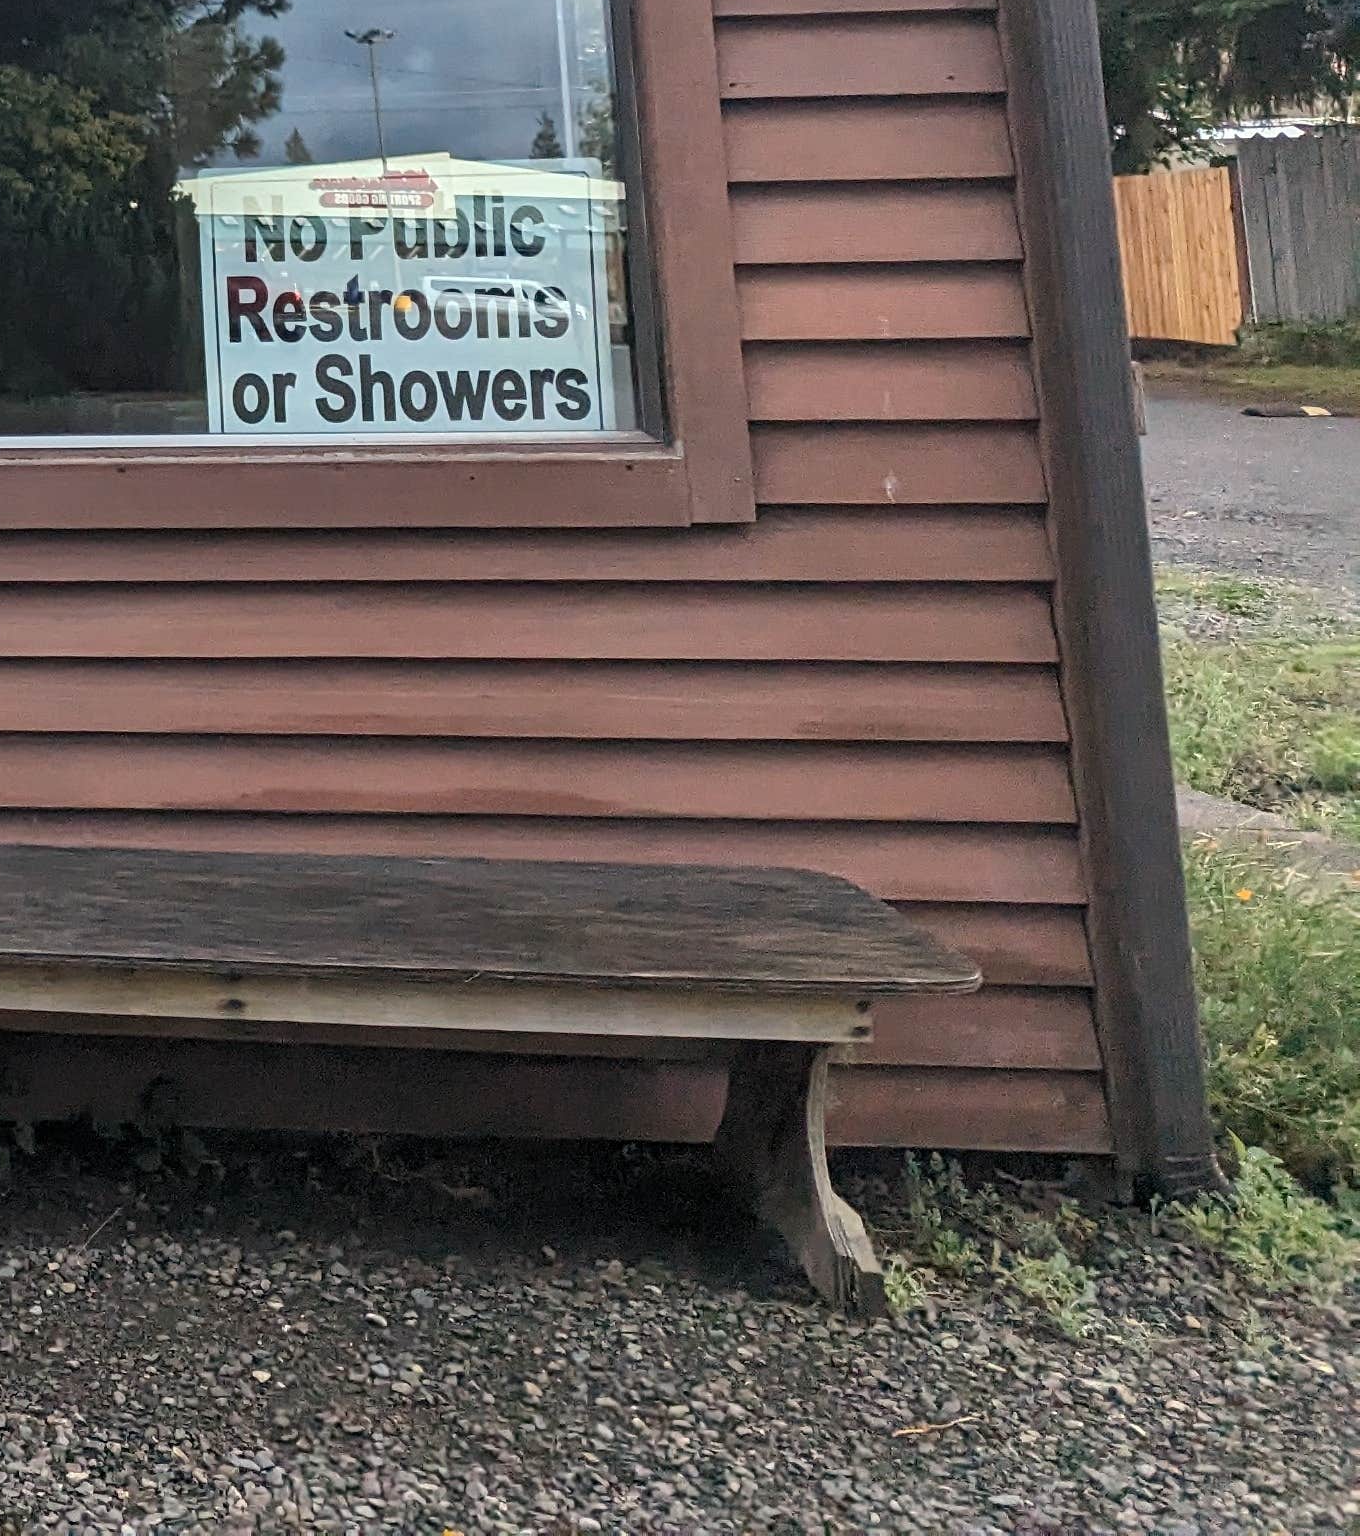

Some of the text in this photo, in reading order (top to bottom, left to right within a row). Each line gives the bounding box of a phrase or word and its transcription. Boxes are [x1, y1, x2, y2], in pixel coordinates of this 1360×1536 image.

[242, 194, 545, 263] No Public
[226, 273, 571, 343] Restrooms
[232, 353, 592, 424] or Showers
